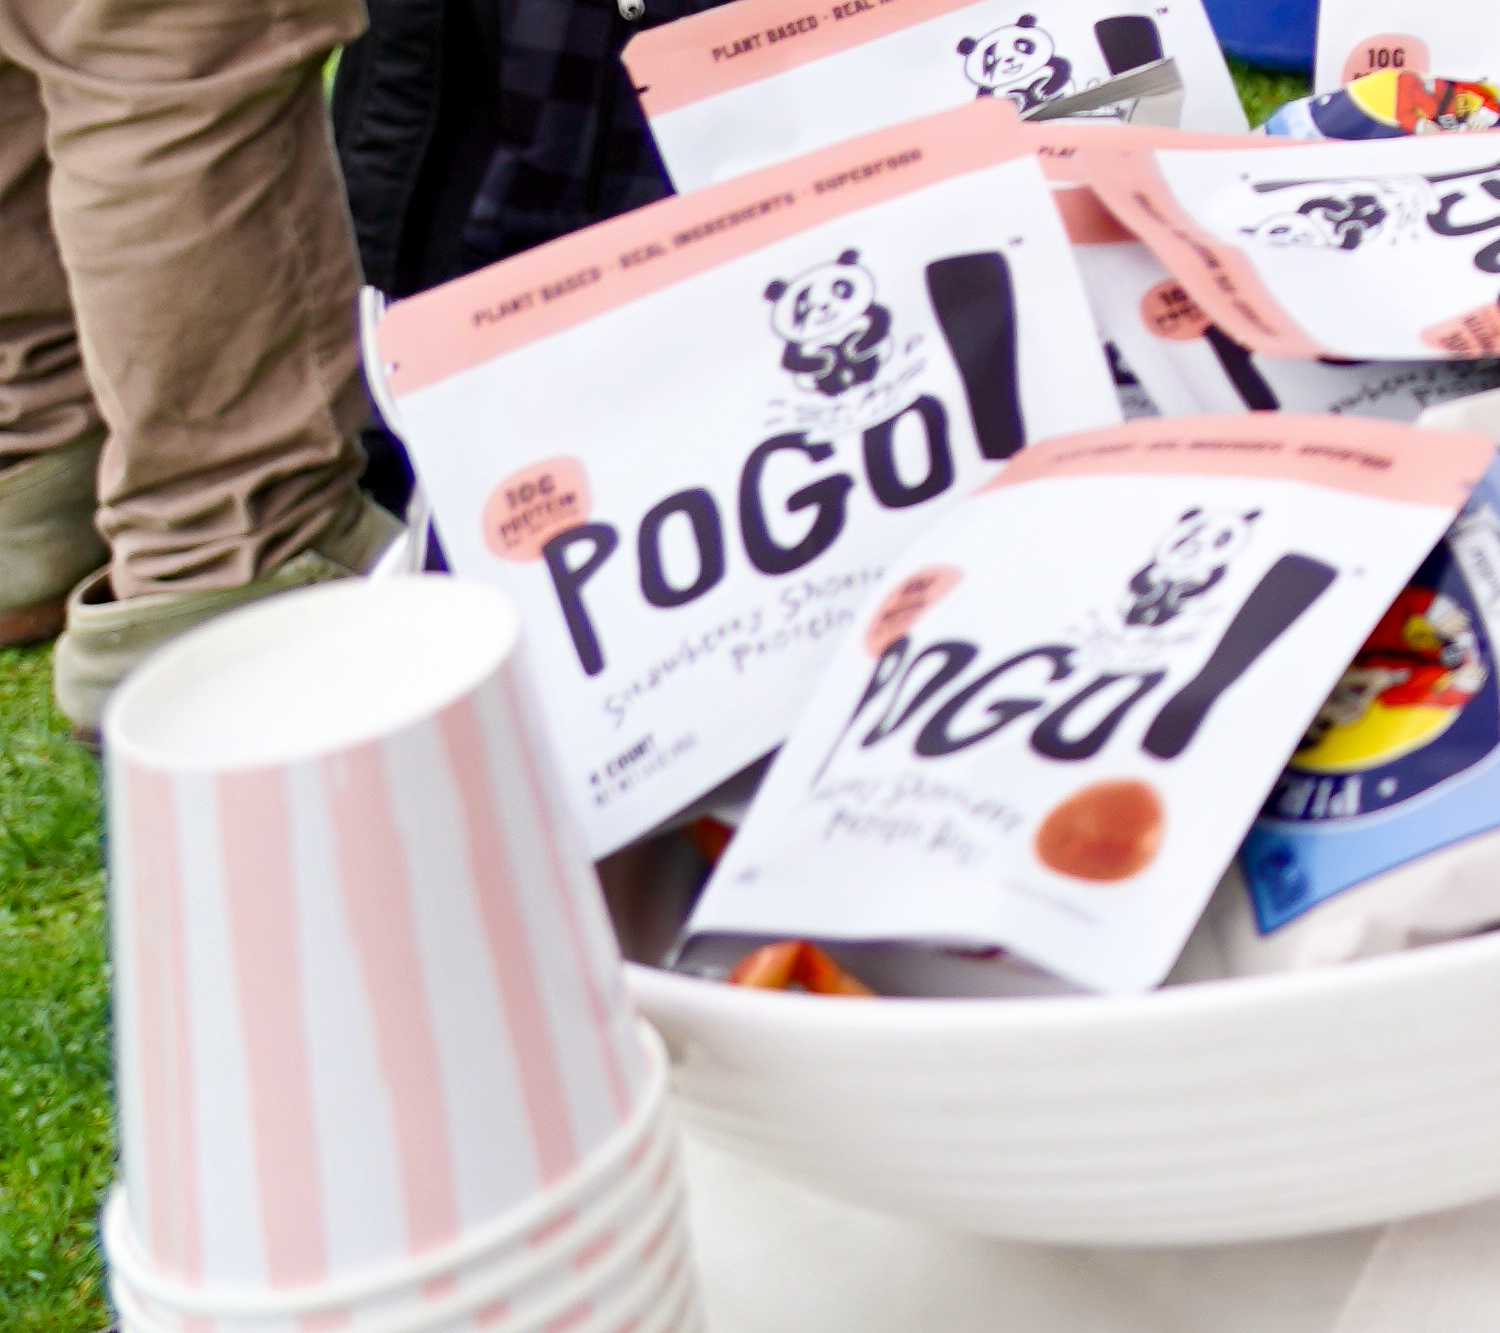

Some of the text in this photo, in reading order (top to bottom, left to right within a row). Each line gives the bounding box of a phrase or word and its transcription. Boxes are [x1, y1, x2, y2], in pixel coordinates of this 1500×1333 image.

[712, 34, 761, 63] PLANT
[767, 15, 820, 45] BASED
[1367, 47, 1406, 68] 10G
